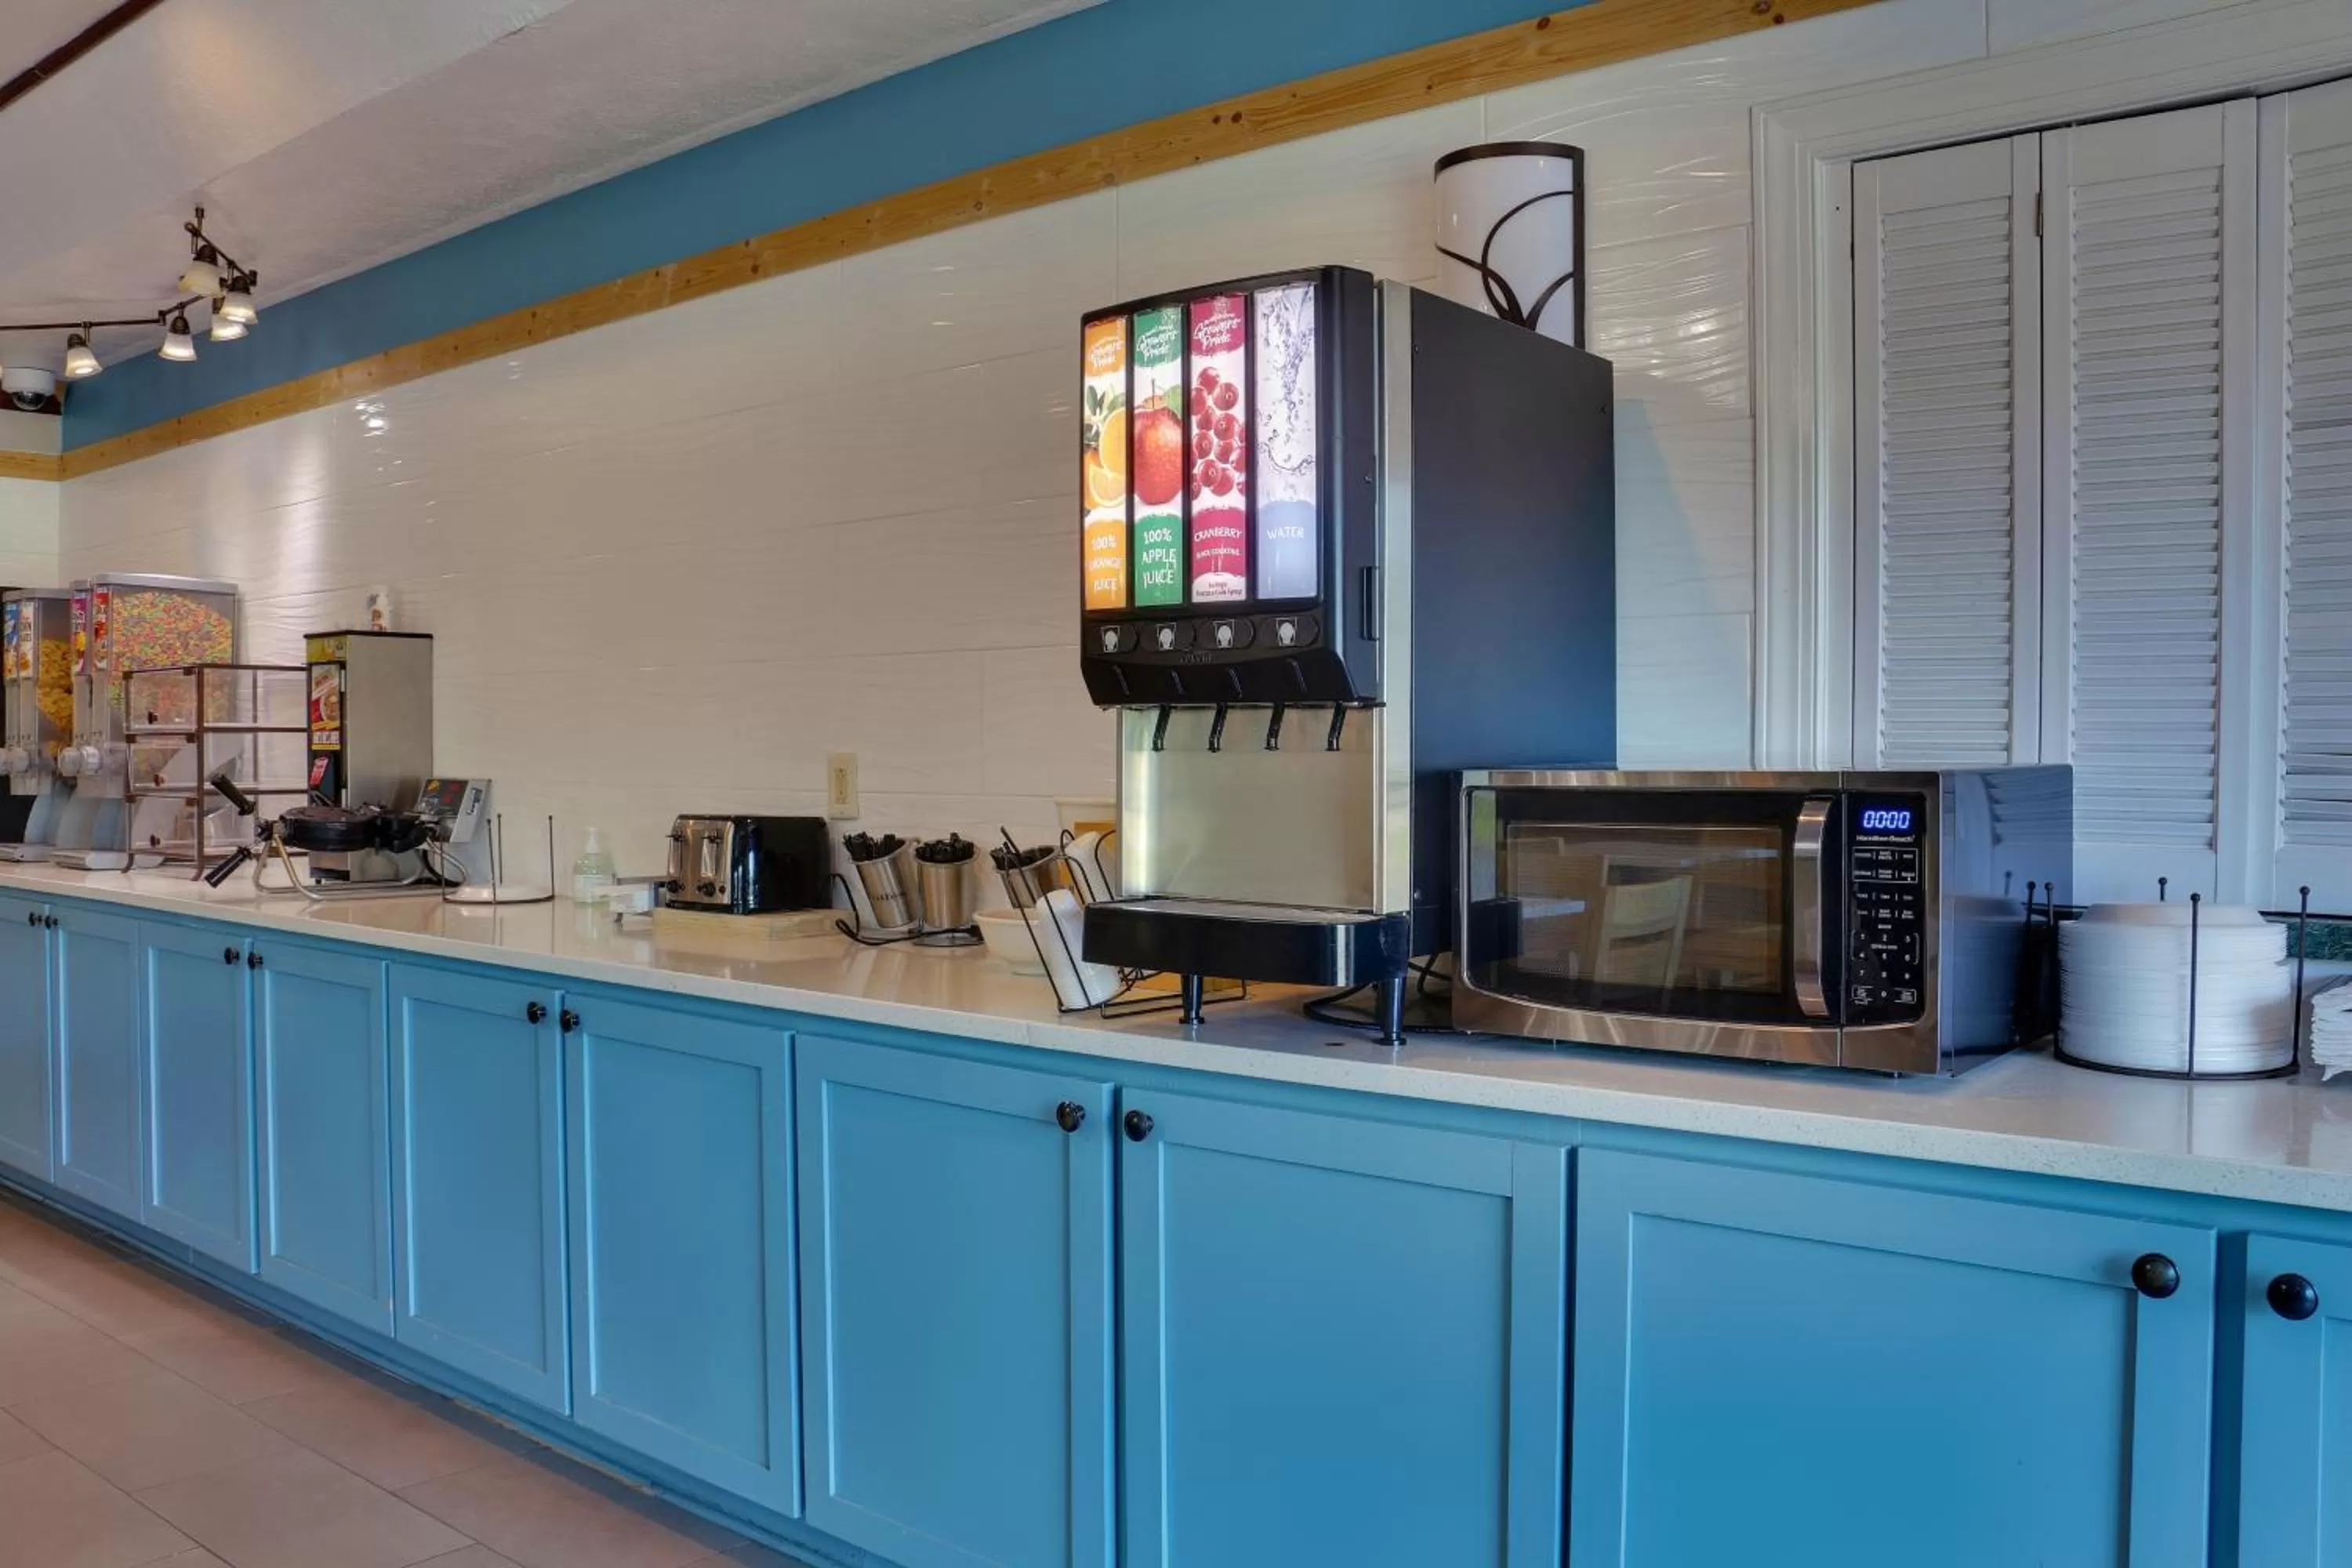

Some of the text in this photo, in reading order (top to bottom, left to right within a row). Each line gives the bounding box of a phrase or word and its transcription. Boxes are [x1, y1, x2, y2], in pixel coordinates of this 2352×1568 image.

[1143, 528, 1172, 544] 100%
[1194, 526, 1242, 542] CRANBERRY
[1266, 526, 1305, 540] WATER
[1142, 548, 1177, 564] APPLE
[1142, 569, 1174, 589] JUICE
